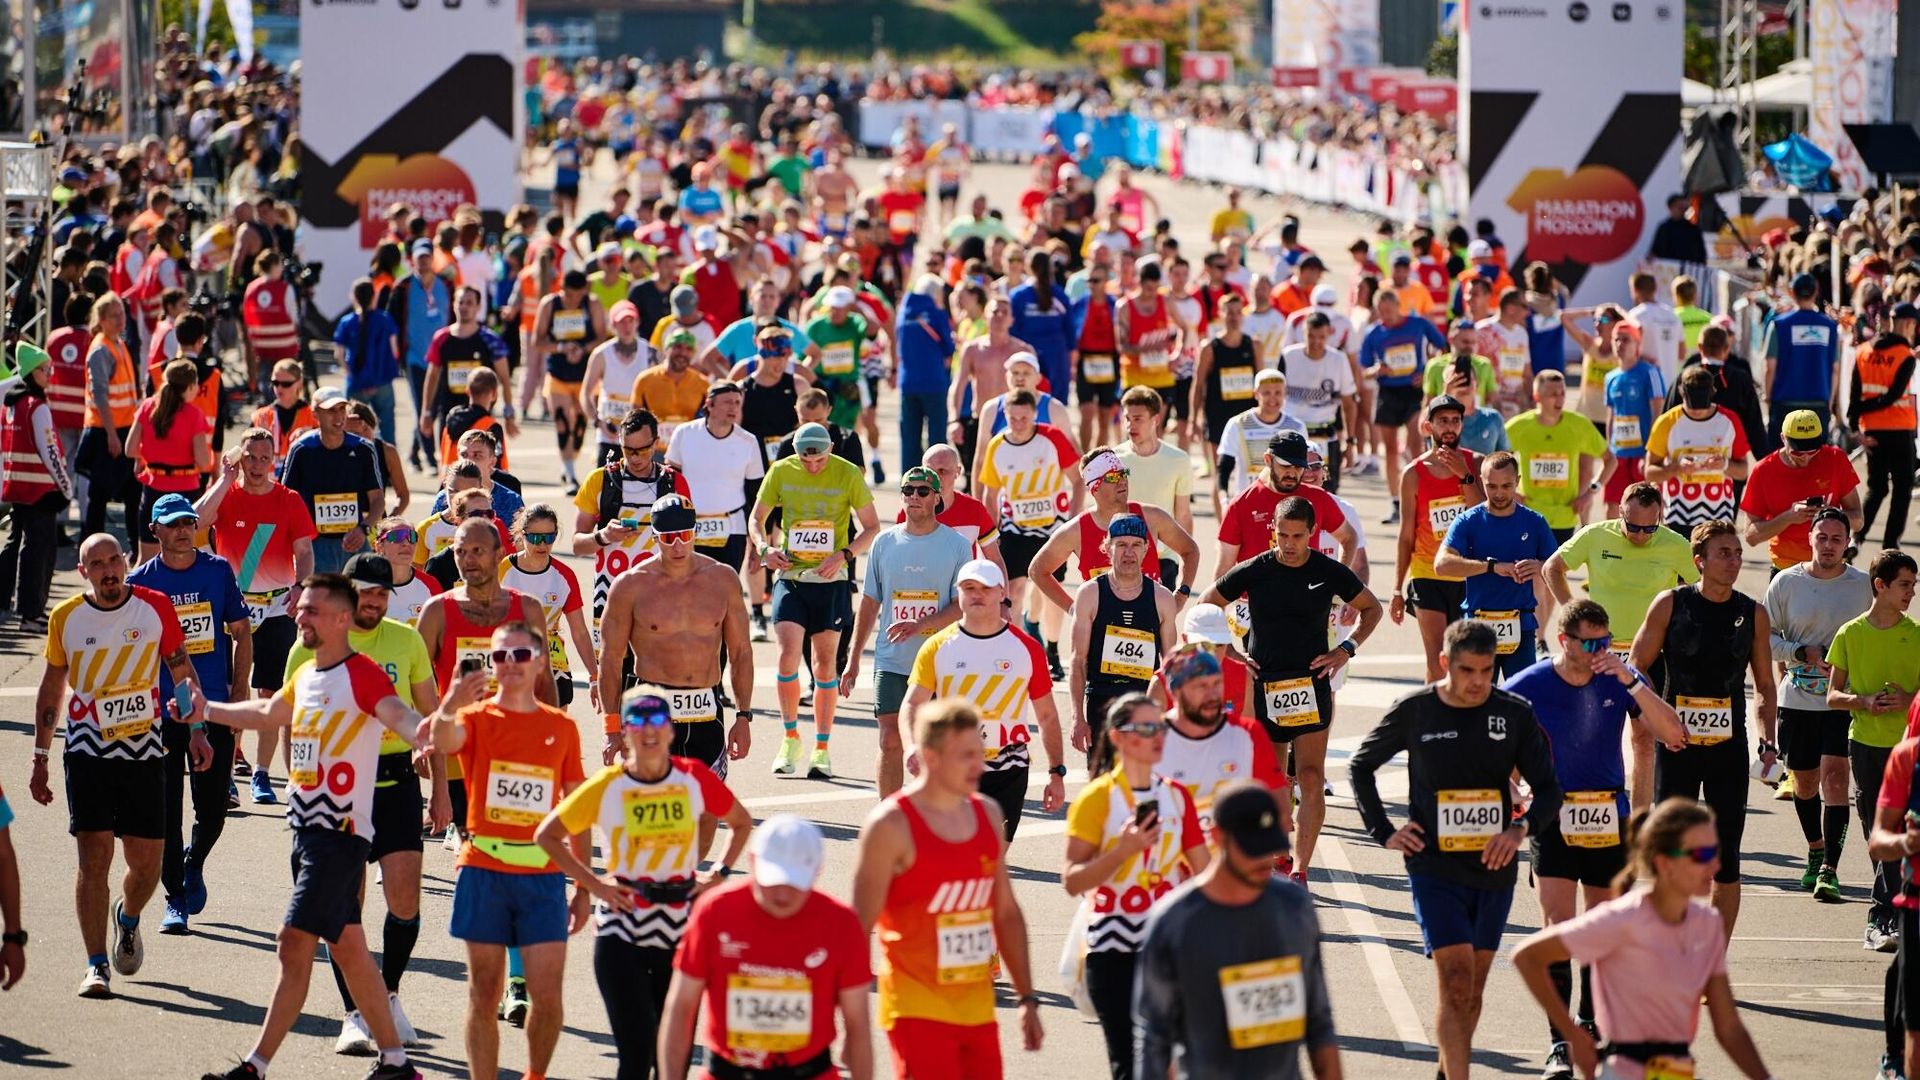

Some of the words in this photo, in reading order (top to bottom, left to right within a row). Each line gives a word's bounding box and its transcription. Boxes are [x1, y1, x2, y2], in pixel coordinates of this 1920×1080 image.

[367, 188, 464, 203] МАРАФОН
[1535, 201, 1636, 218] MARATHON
[1535, 217, 1614, 235] MOSCOW
[1535, 462, 1564, 474] 7882
[317, 504, 356, 518] 11399
[1015, 500, 1051, 514] 12703
[795, 531, 828, 545] 7448
[184, 592, 200, 604] БЕГ
[180, 615, 211, 634] 257
[1492, 623, 1513, 637] 21
[1114, 641, 1144, 659] 484
[104, 695, 146, 718] 9748
[673, 693, 711, 710] 5104
[1273, 691, 1310, 709] 6202
[1488, 716, 1506, 731] FR
[1679, 711, 1730, 728] 14926
[496, 779, 544, 803] 5493
[632, 802, 685, 825] 9718
[1442, 807, 1500, 825] 10480
[1568, 808, 1611, 825] 1046
[735, 996, 807, 1021] 13466
